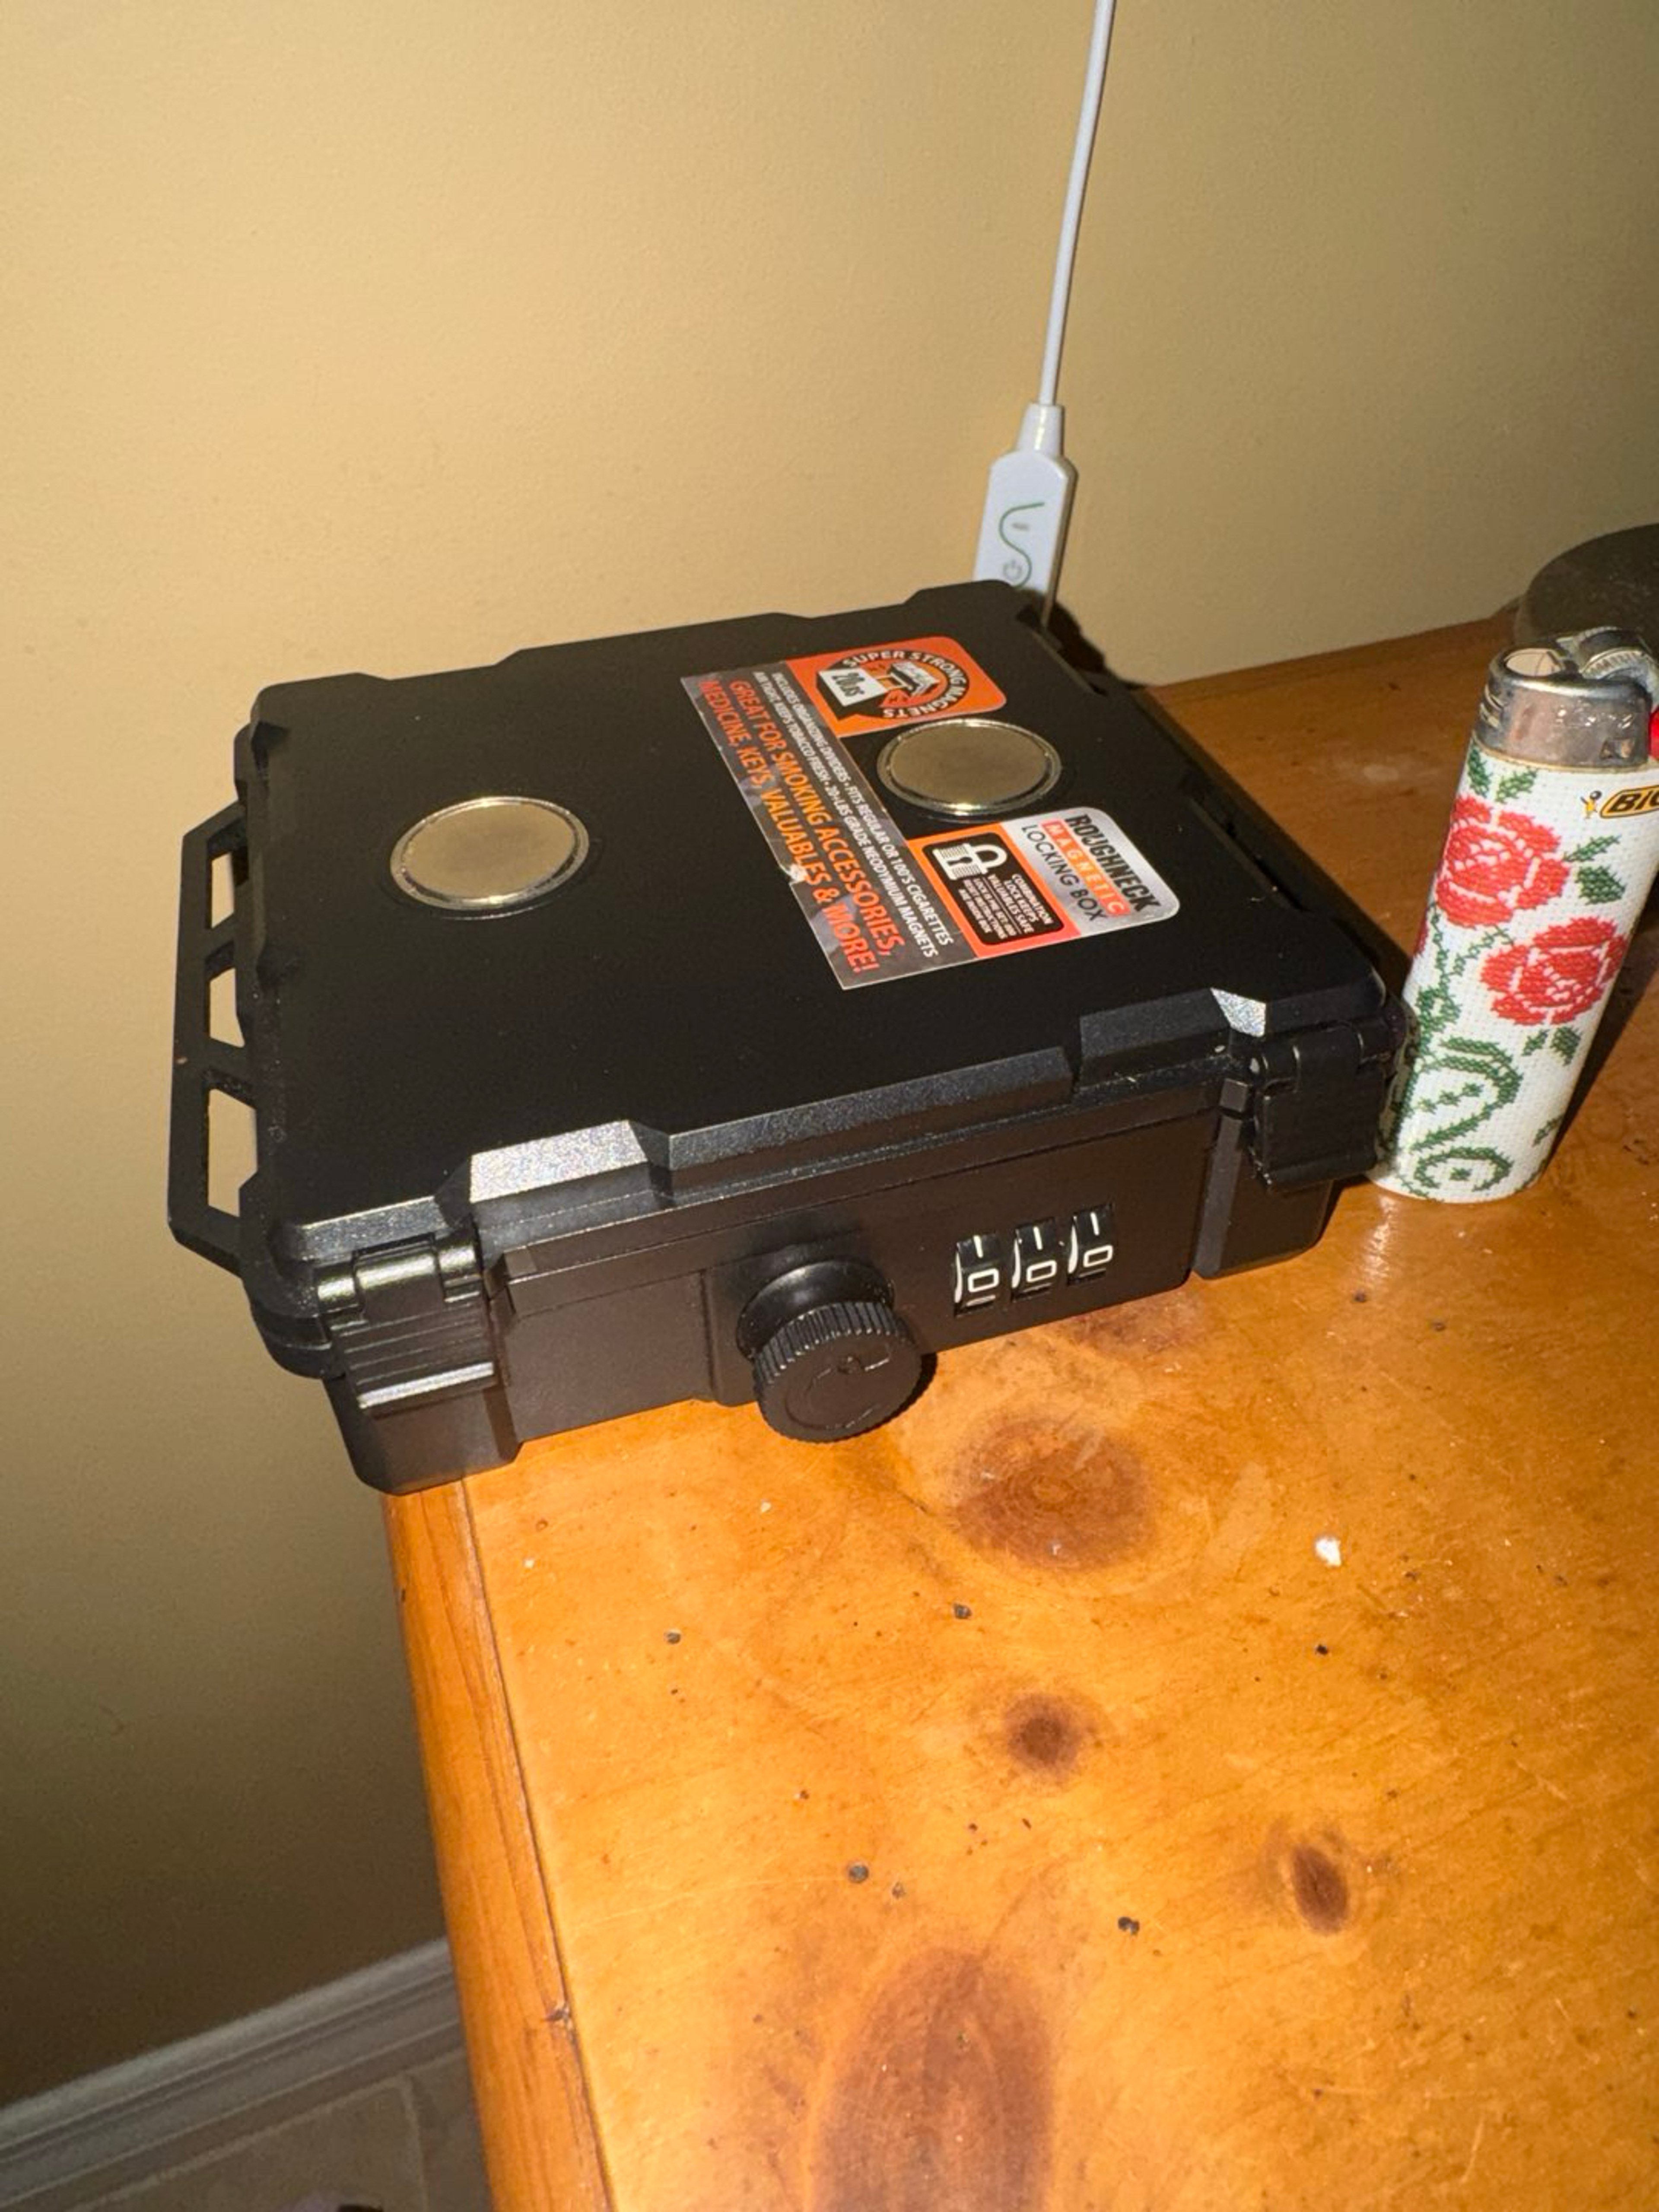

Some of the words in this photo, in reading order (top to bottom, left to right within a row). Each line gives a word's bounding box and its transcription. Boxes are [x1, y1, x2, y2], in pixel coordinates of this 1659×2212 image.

[843, 651, 905, 667] SUPER
[910, 652, 966, 686] STRONG
[729, 680, 771, 722] GREAT
[883, 686, 966, 718] MAGNETS
[757, 721, 788, 752] FOR
[772, 751, 831, 826] SMOKING
[761, 789, 831, 885] VALUABLES
[788, 723, 816, 757] TOBACCO
[807, 756, 831, 782] FRESH
[843, 816, 872, 847] GRADE
[863, 846, 908, 906] NEODYMIUM
[898, 906, 939, 958] MAGNETS
[820, 746, 851, 783] DIVIDERS
[845, 786, 865, 805] FITS
[856, 804, 891, 844] REGULAR
[881, 842, 899, 859] OR
[891, 858, 916, 885] 100'S
[907, 884, 954, 945] CIGARETTES
[1046, 823, 1124, 913] MAGNETIC
[1064, 814, 1160, 911] ROUGHNECK
[811, 885, 839, 904] &
[815, 826, 903, 955] ACCESSORIES,
[988, 874, 1021, 915] VALUABLES
[1004, 880, 1023, 899] LOCK
[1022, 825, 1079, 885] LOCKING
[1071, 889, 1107, 921] BOX
[824, 903, 878, 973] MORE!
